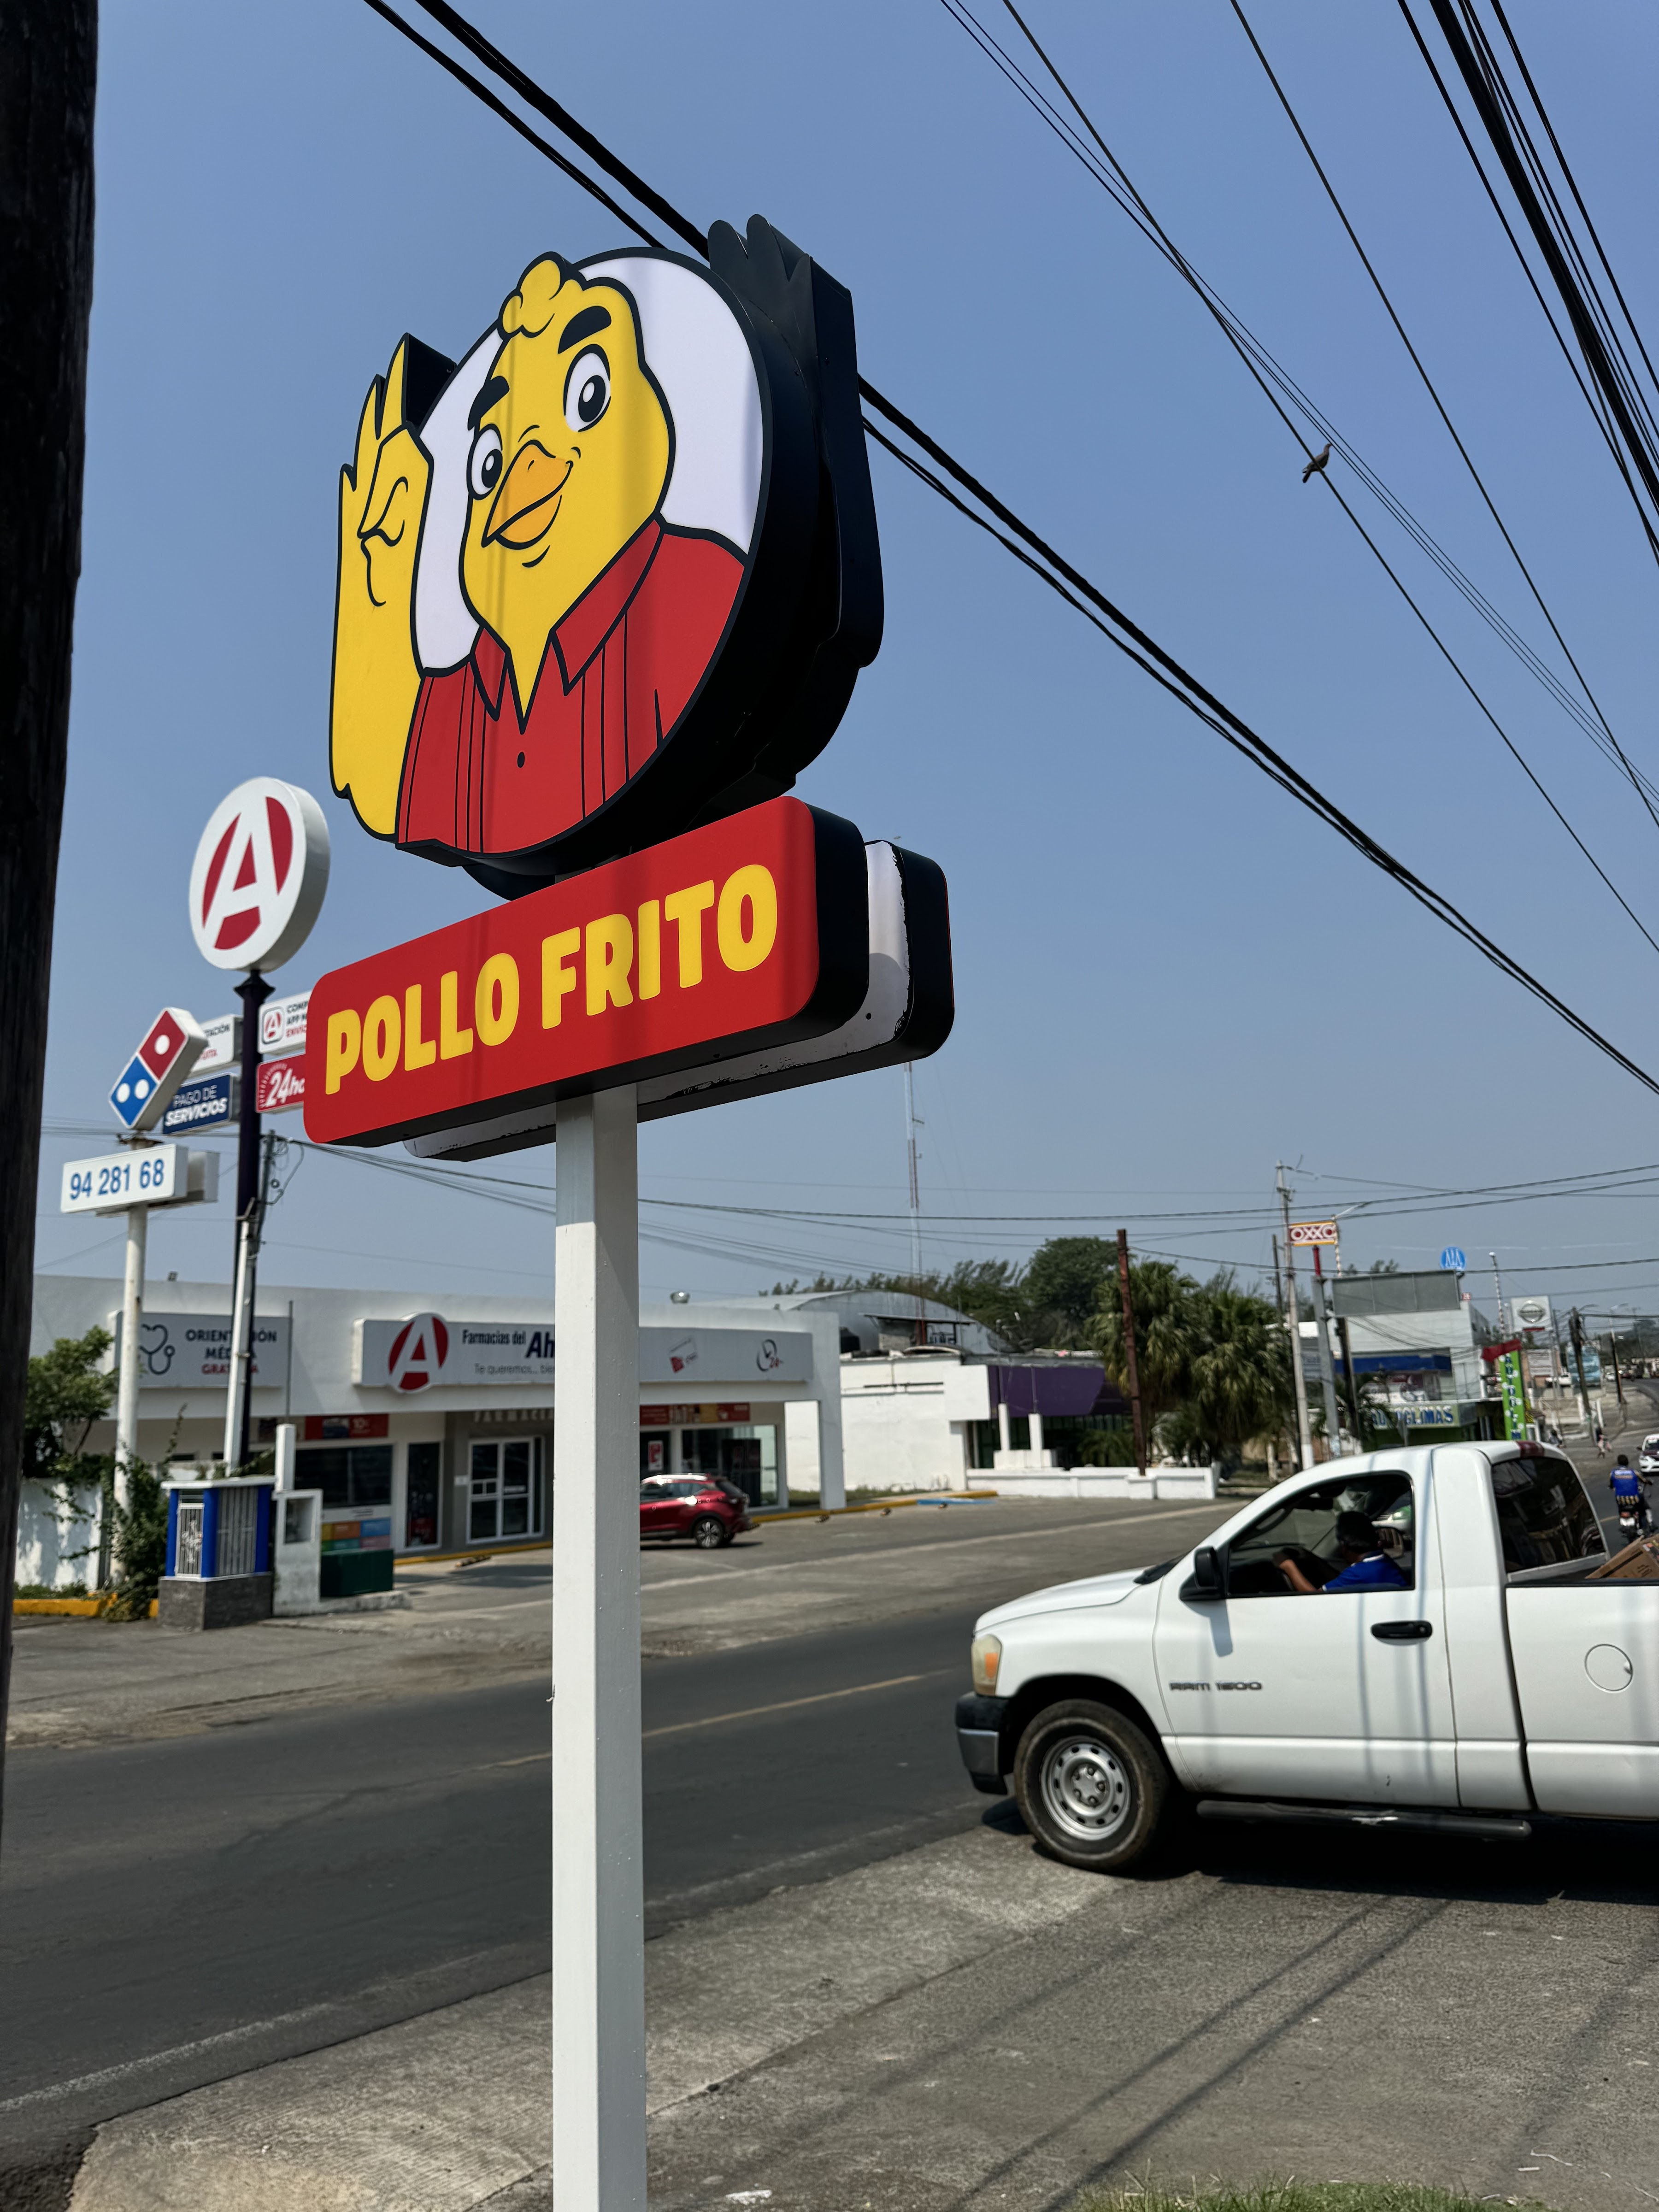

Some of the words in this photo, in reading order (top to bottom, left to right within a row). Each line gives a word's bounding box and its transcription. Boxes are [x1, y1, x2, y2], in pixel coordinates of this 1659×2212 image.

[325, 952, 520, 1095] POLLO
[541, 864, 778, 1030] FRITO
[172, 1089, 201, 1108] PAGO
[201, 1084, 218, 1101] DE
[165, 1097, 228, 1127] SERVICIOS
[70, 1171, 92, 1200] 94
[98, 1164, 130, 1195] 281
[140, 1159, 164, 1189] 68
[462, 1329, 510, 1345] Farmacias
[512, 1330, 526, 1345] del
[1170, 1682, 1210, 1691] RAM
